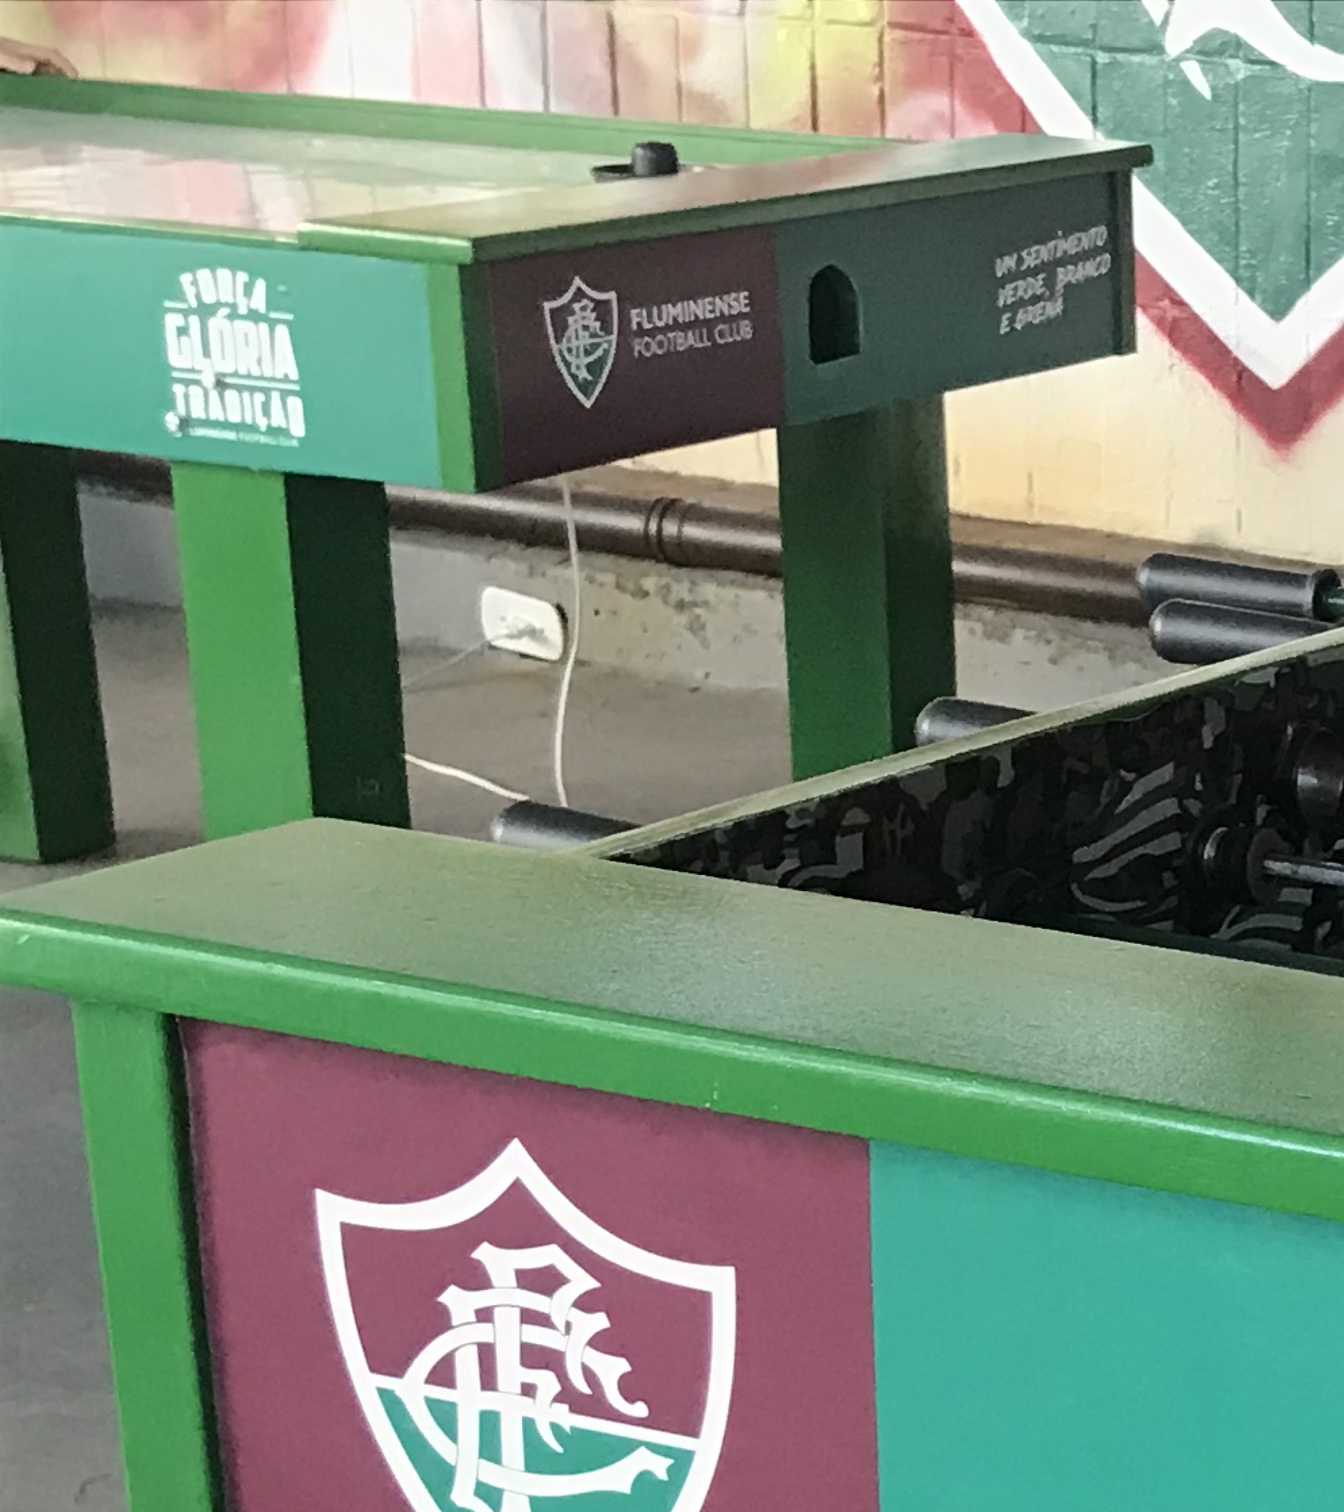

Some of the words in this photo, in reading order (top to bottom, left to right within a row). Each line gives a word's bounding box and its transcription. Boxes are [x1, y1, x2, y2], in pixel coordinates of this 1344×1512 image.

[630, 291, 751, 331] FLUMINENSE
[164, 306, 299, 381] GLÓRIA
[631, 327, 712, 358] FOOTBALL
[713, 319, 754, 345] CLUB
